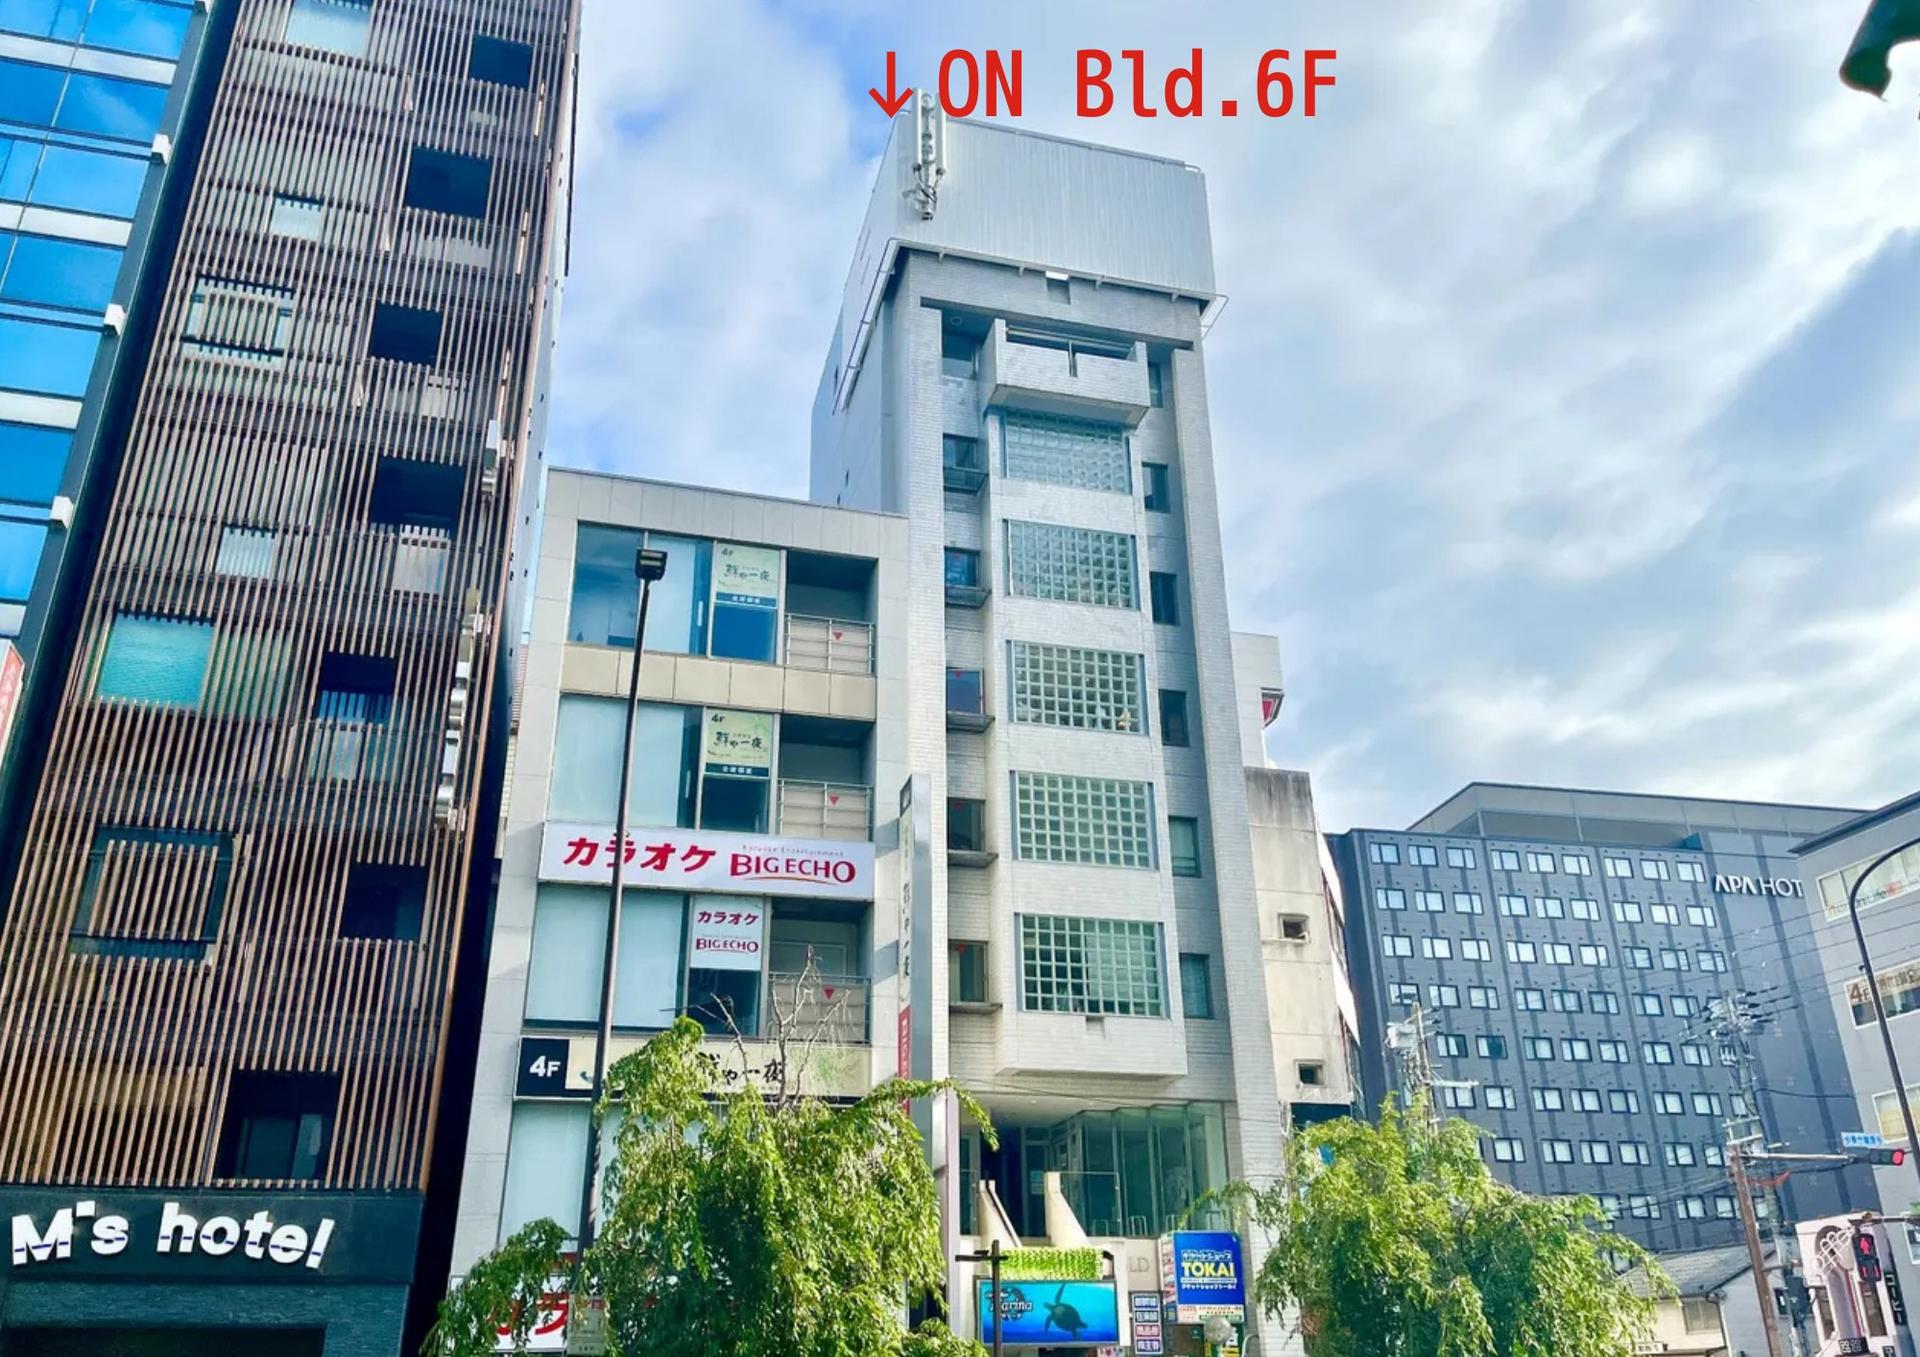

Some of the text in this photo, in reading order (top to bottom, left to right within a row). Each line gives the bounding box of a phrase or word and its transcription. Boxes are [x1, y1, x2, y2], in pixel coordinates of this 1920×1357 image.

[563, 837, 716, 873] カラオケ
[1715, 875, 1758, 895] APA
[697, 910, 759, 926] カラオケ
[529, 1055, 561, 1077] 4F
[11, 1200, 336, 1270] M's hotel
[1181, 1262, 1235, 1278] TOKAI
[990, 1300, 1033, 1312] arina
